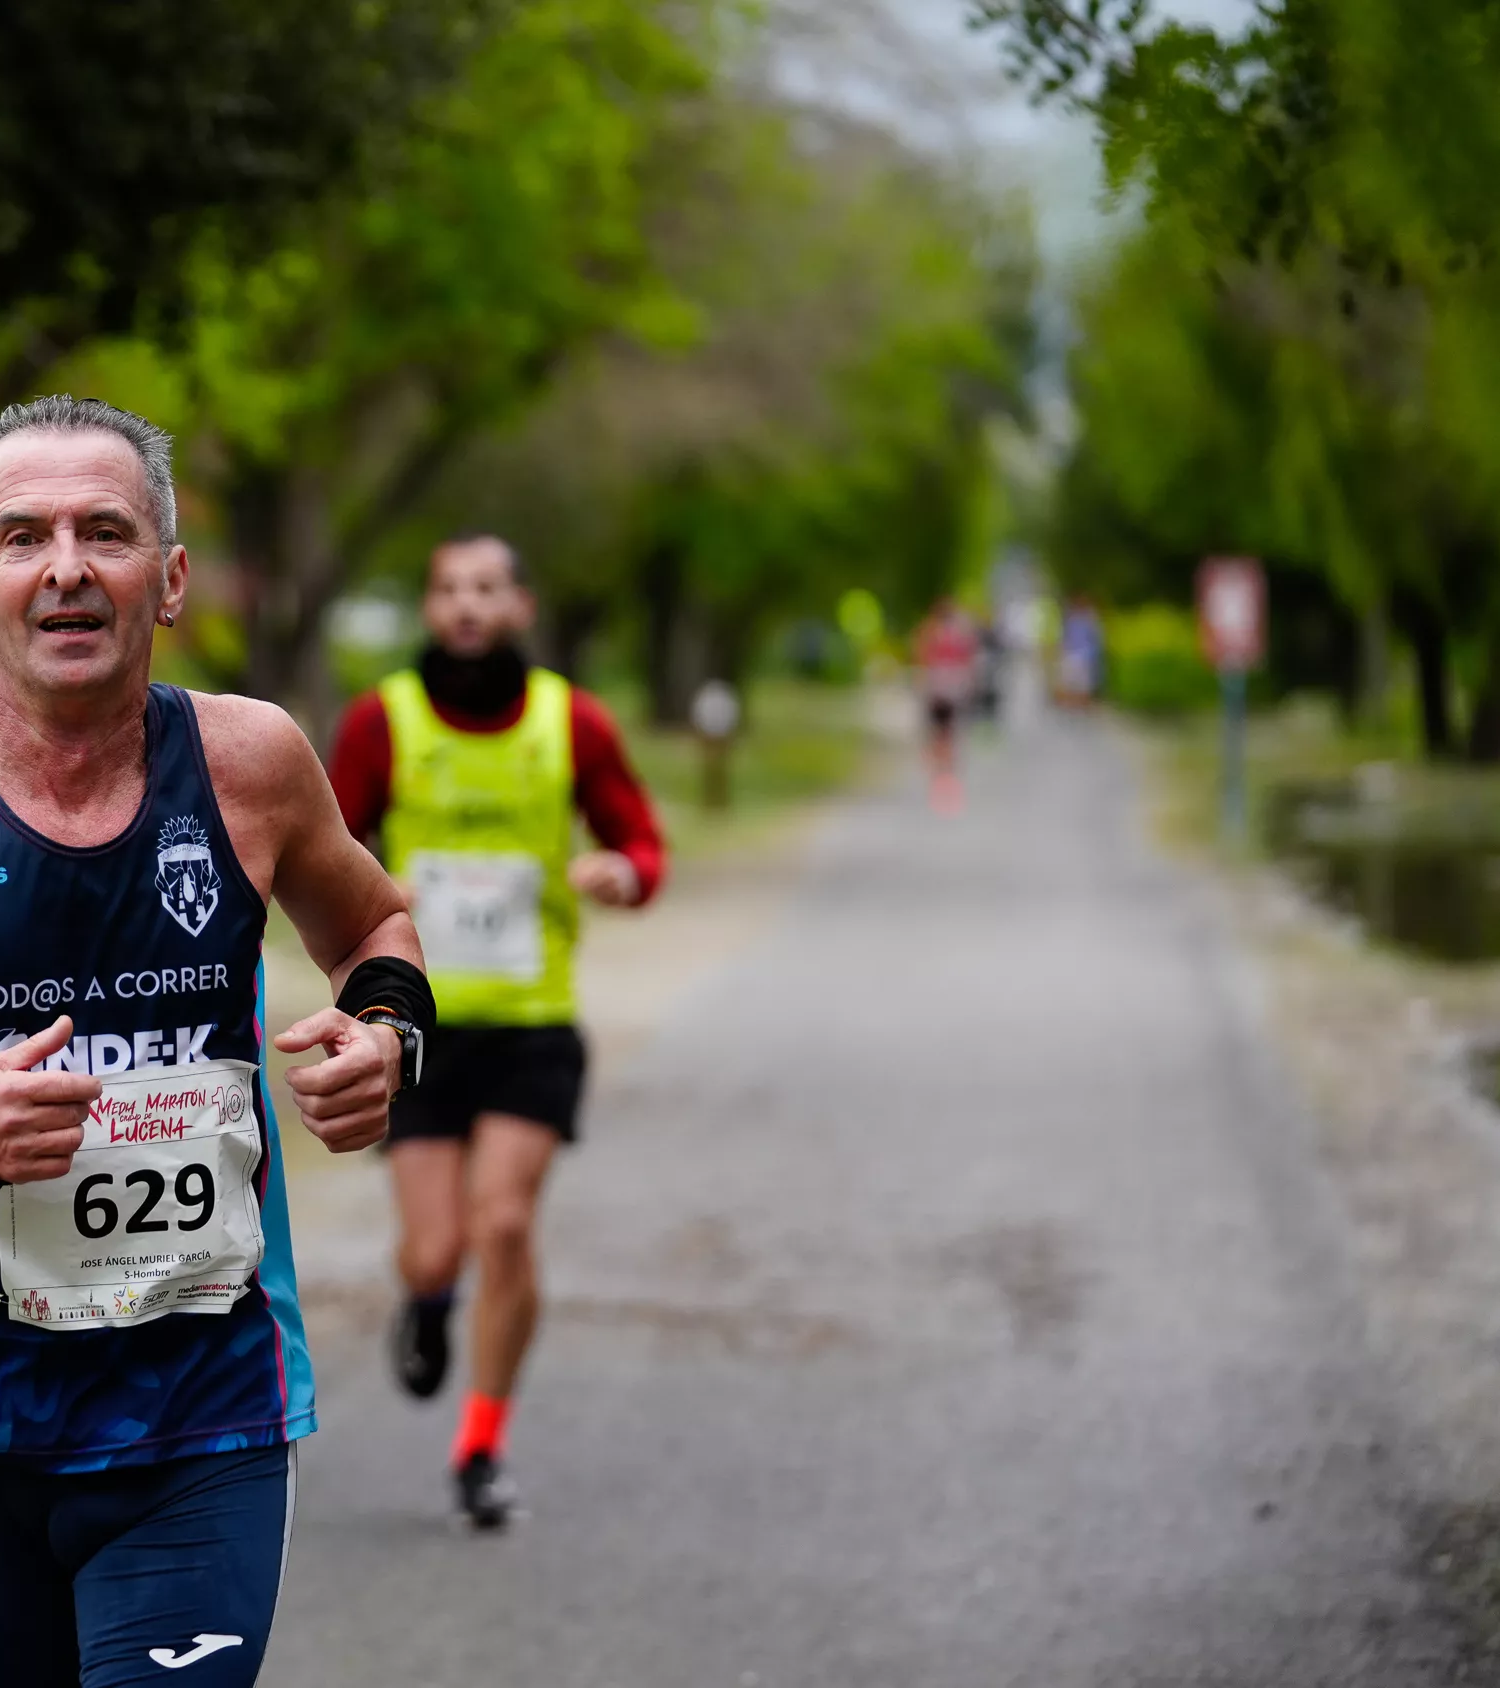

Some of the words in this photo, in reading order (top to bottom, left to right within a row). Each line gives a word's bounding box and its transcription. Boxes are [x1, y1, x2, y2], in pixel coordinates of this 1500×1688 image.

[85, 976, 106, 1001] A
[115, 964, 229, 998] CORRER
[97, 1097, 136, 1117] MEDIA
[145, 1089, 206, 1112] MARATÓN
[110, 1116, 195, 1143] LUCENA
[73, 1163, 215, 1238] 629
[80, 1258, 103, 1269] JOSE
[105, 1256, 137, 1267] ÁNGEL
[139, 1254, 176, 1265] MURIEL
[178, 1249, 212, 1263] GARCÍA
[124, 1269, 171, 1279] S-Hombre
